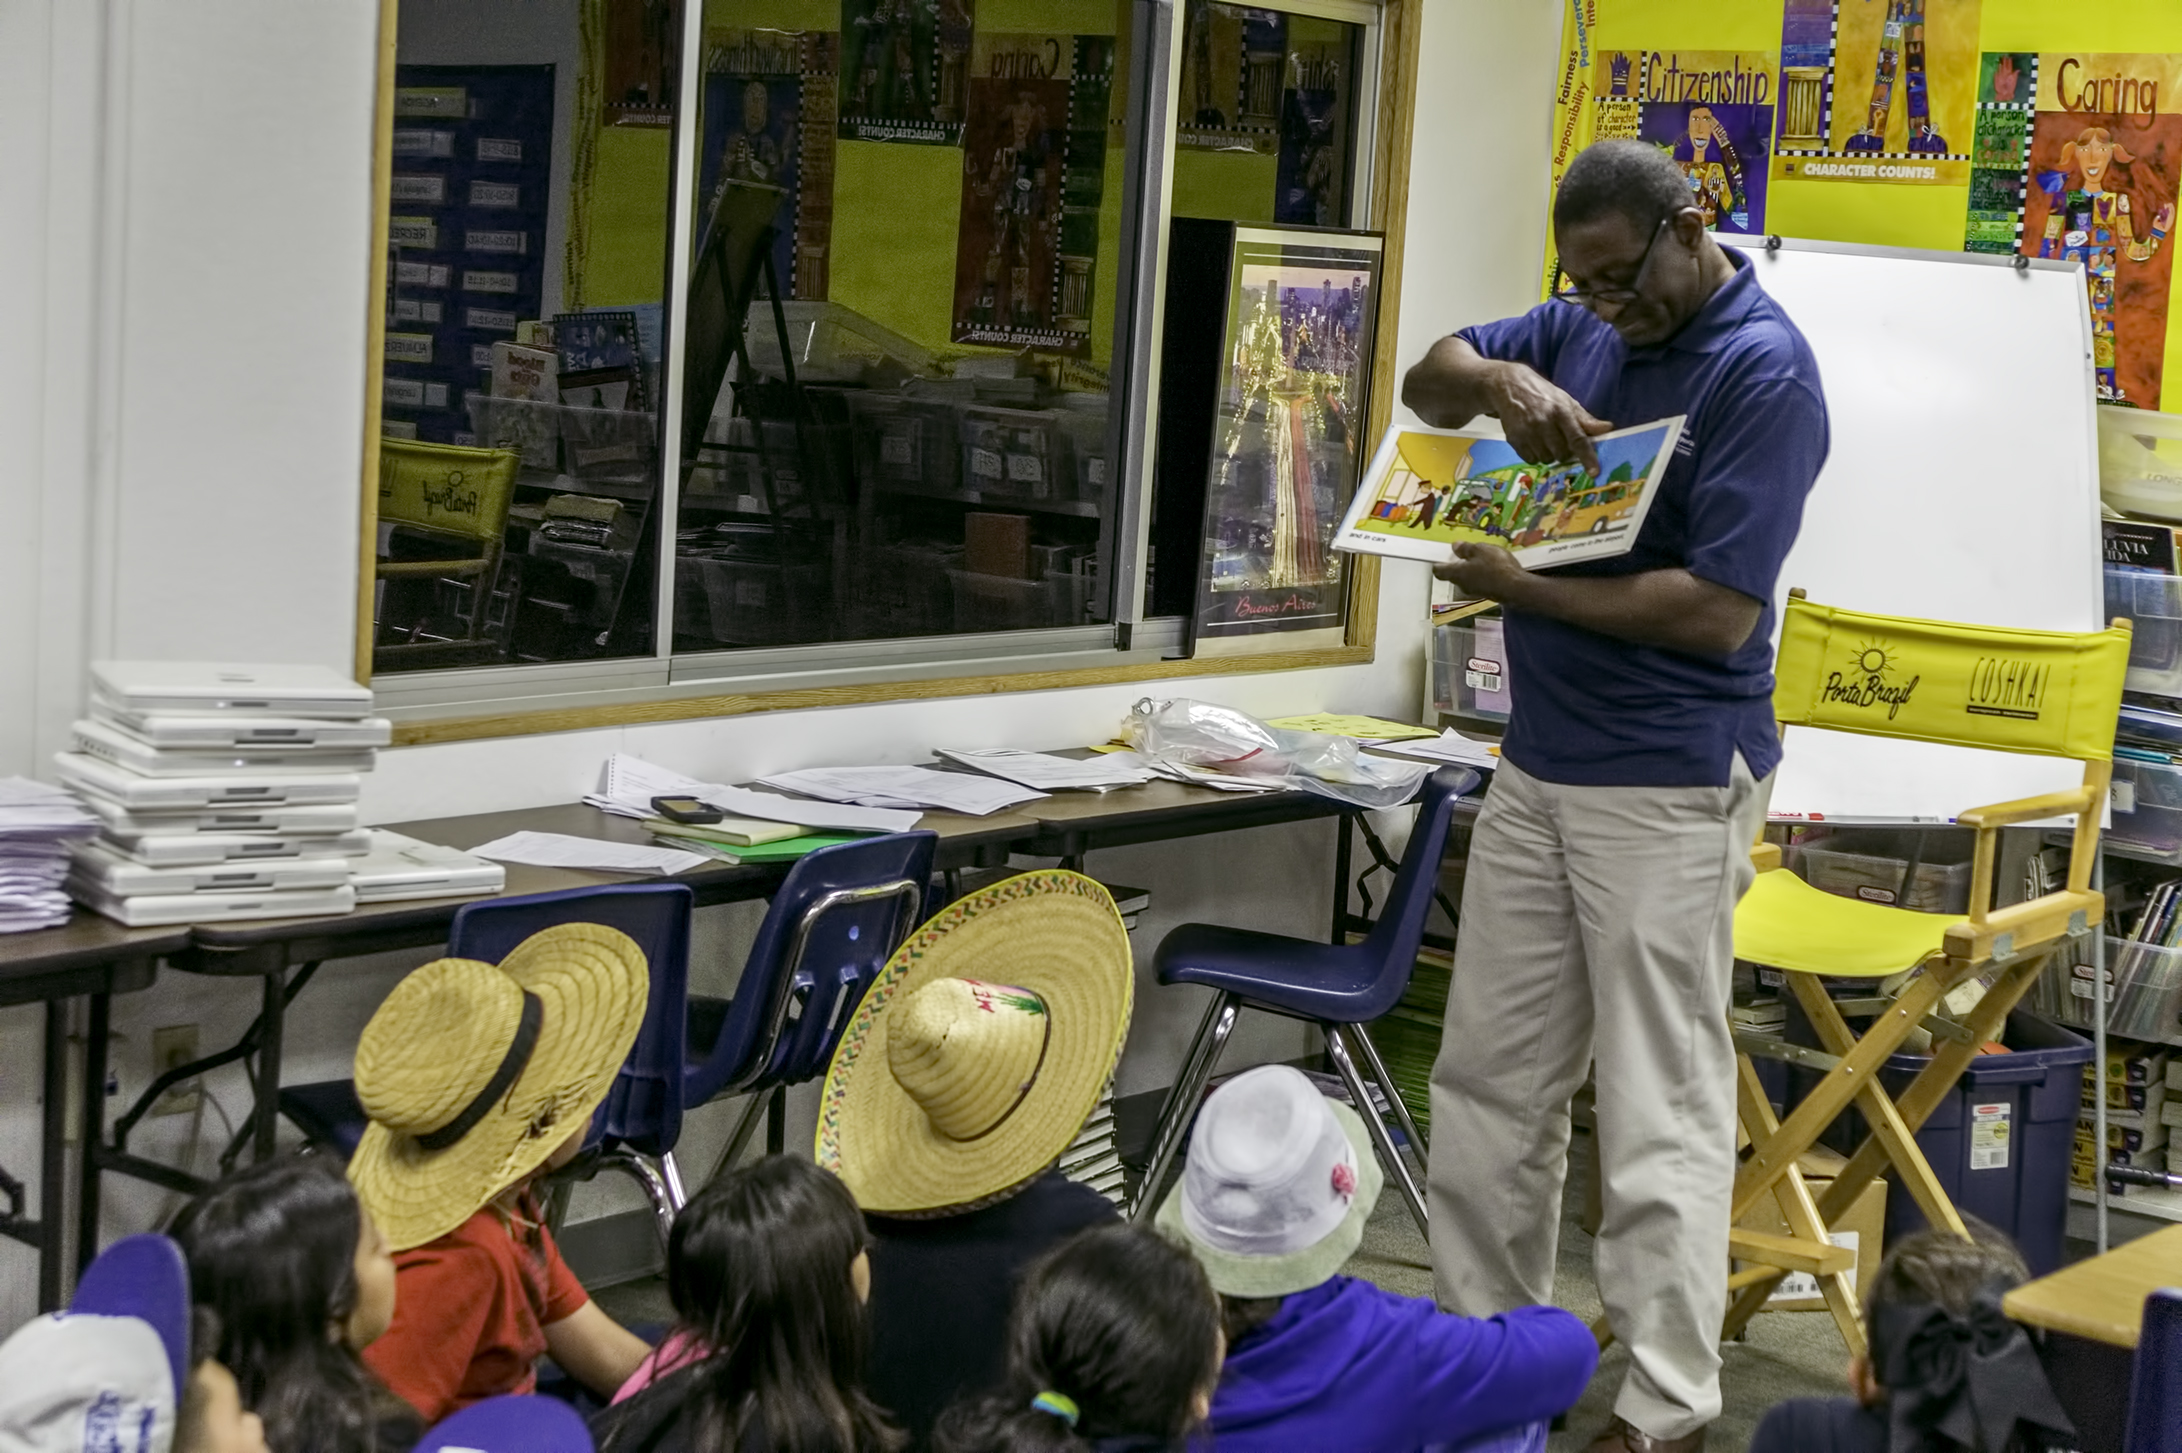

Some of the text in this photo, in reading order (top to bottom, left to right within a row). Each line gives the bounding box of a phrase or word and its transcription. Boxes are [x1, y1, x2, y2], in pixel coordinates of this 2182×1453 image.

[1557, 50, 1579, 105] Fairness
[1647, 52, 1767, 104] Citizenship
[2057, 58, 2158, 131] Caring
[1606, 103, 1631, 115] person
[1990, 110, 2025, 122] person
[1554, 81, 1590, 166] Responsibility
[1804, 163, 1936, 179] CHARACTER COUNTS!
[1235, 593, 1316, 617] Buenos Aires
[1471, 660, 1498, 672] Sterilite
[1969, 657, 2050, 709] COSHKAI
[1862, 889, 1893, 901] Sterilite
